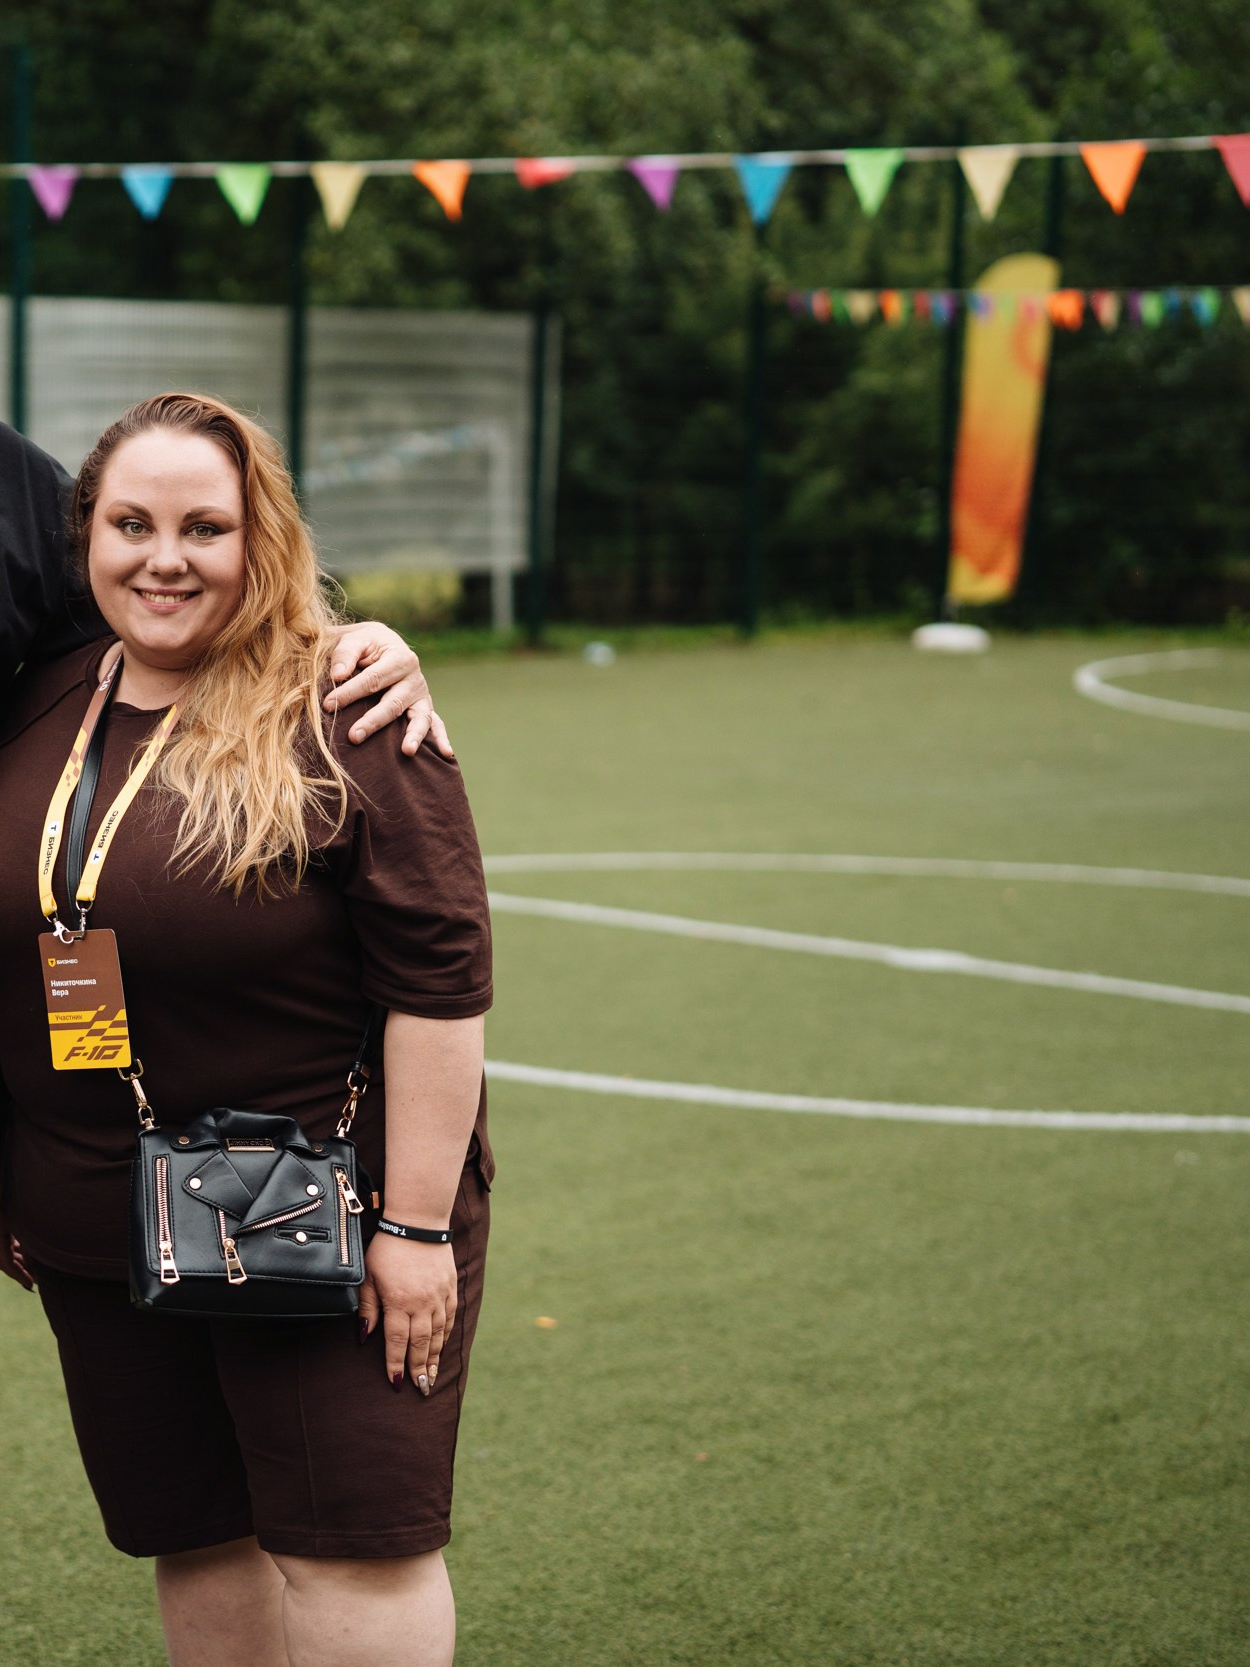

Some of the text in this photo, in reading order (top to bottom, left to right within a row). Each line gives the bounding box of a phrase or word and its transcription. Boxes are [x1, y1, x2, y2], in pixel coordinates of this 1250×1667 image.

[97, 810, 119, 849] БИЗНЕС
[43, 836, 55, 876] БИЗНЕС
[50, 978, 96, 987] Никиточкина
[52, 989, 69, 997] Вера
[63, 1044, 124, 1062] F-10
